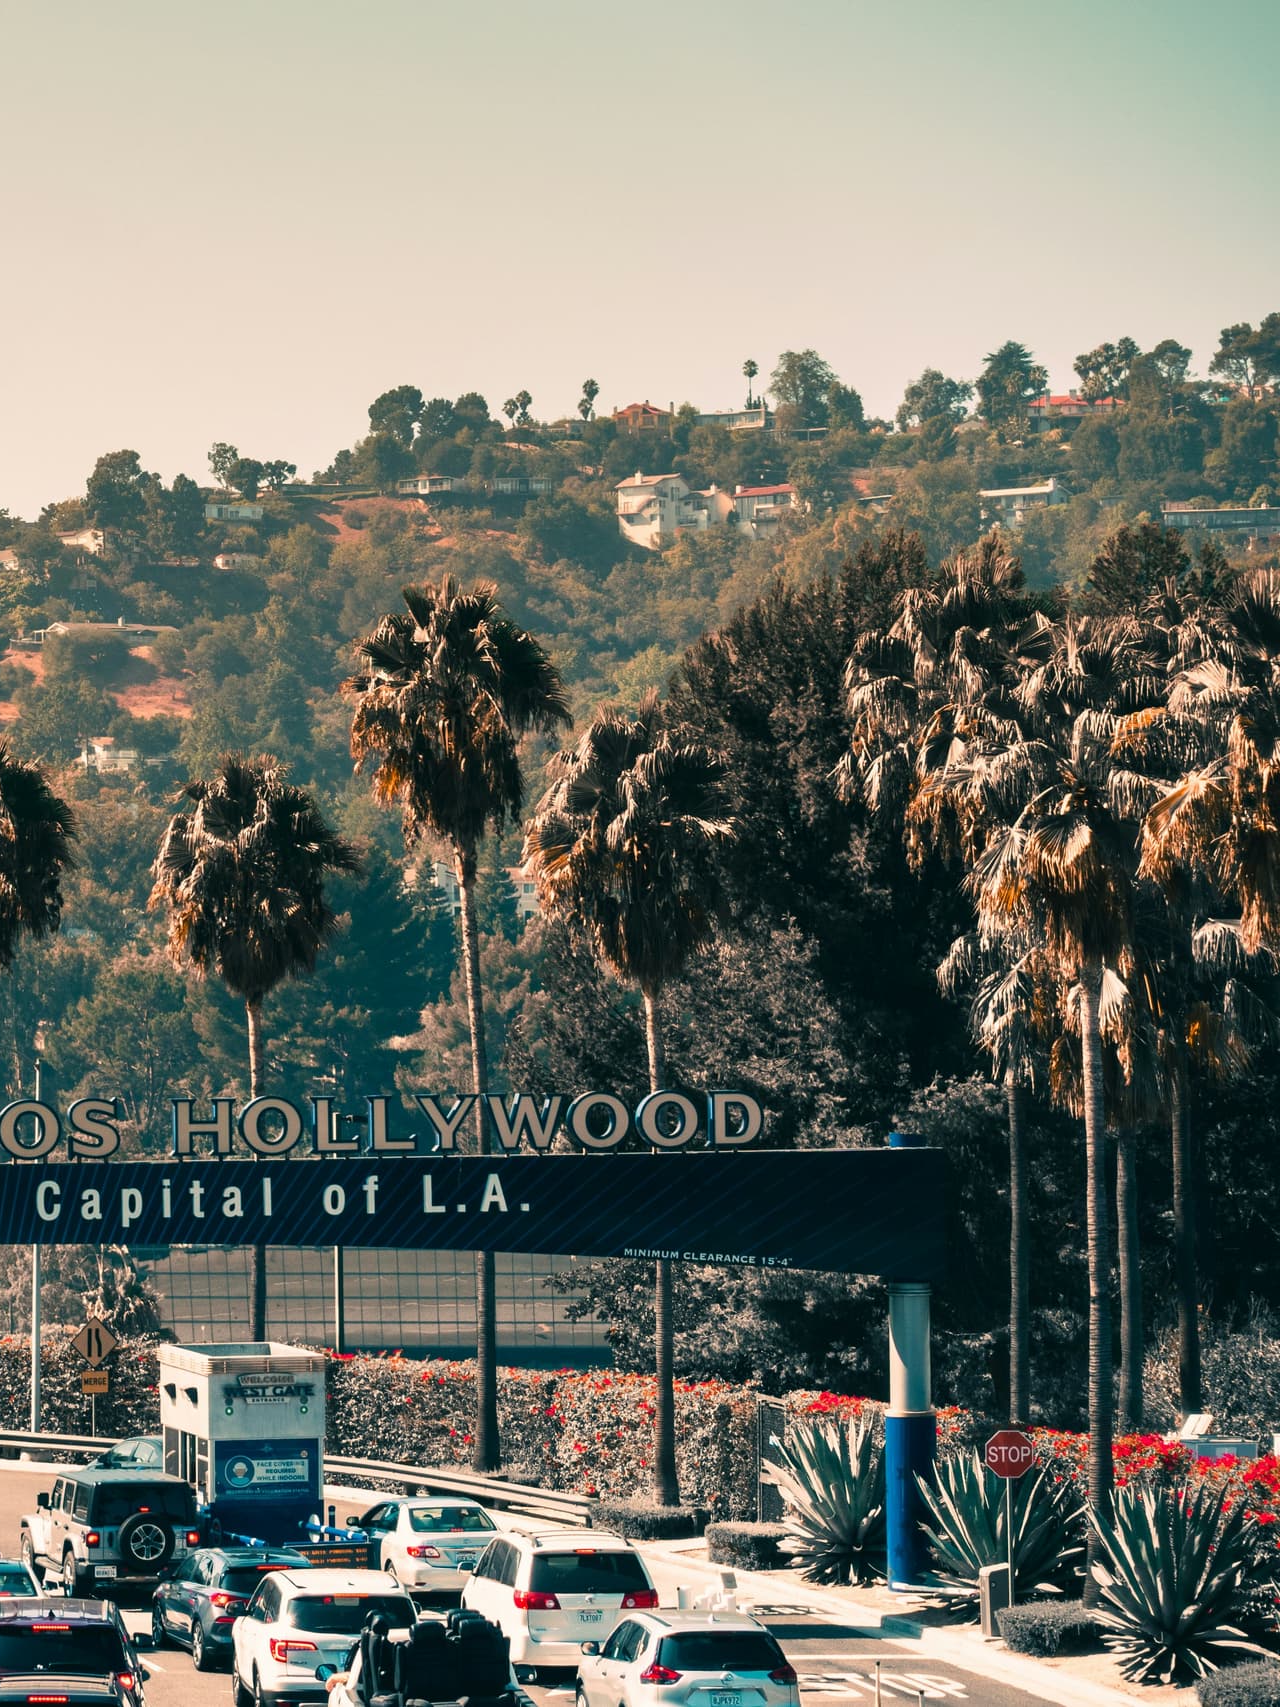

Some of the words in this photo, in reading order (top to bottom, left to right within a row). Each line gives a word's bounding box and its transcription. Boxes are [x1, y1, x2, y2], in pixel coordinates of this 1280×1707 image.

[171, 1090, 765, 1157] HOLLYWOOD
[36, 1176, 273, 1228] Capital
[323, 1175, 380, 1216] of
[423, 1173, 531, 1214] L.A.
[624, 1248, 679, 1260] MINIMUM
[683, 1251, 756, 1264] CLEARANCE
[84, 1377, 107, 1386] MERGE
[240, 1375, 295, 1384] WELCOME
[224, 1386, 268, 1398] WEST
[272, 1384, 315, 1397] GATE
[988, 1446, 1031, 1463] STOP
